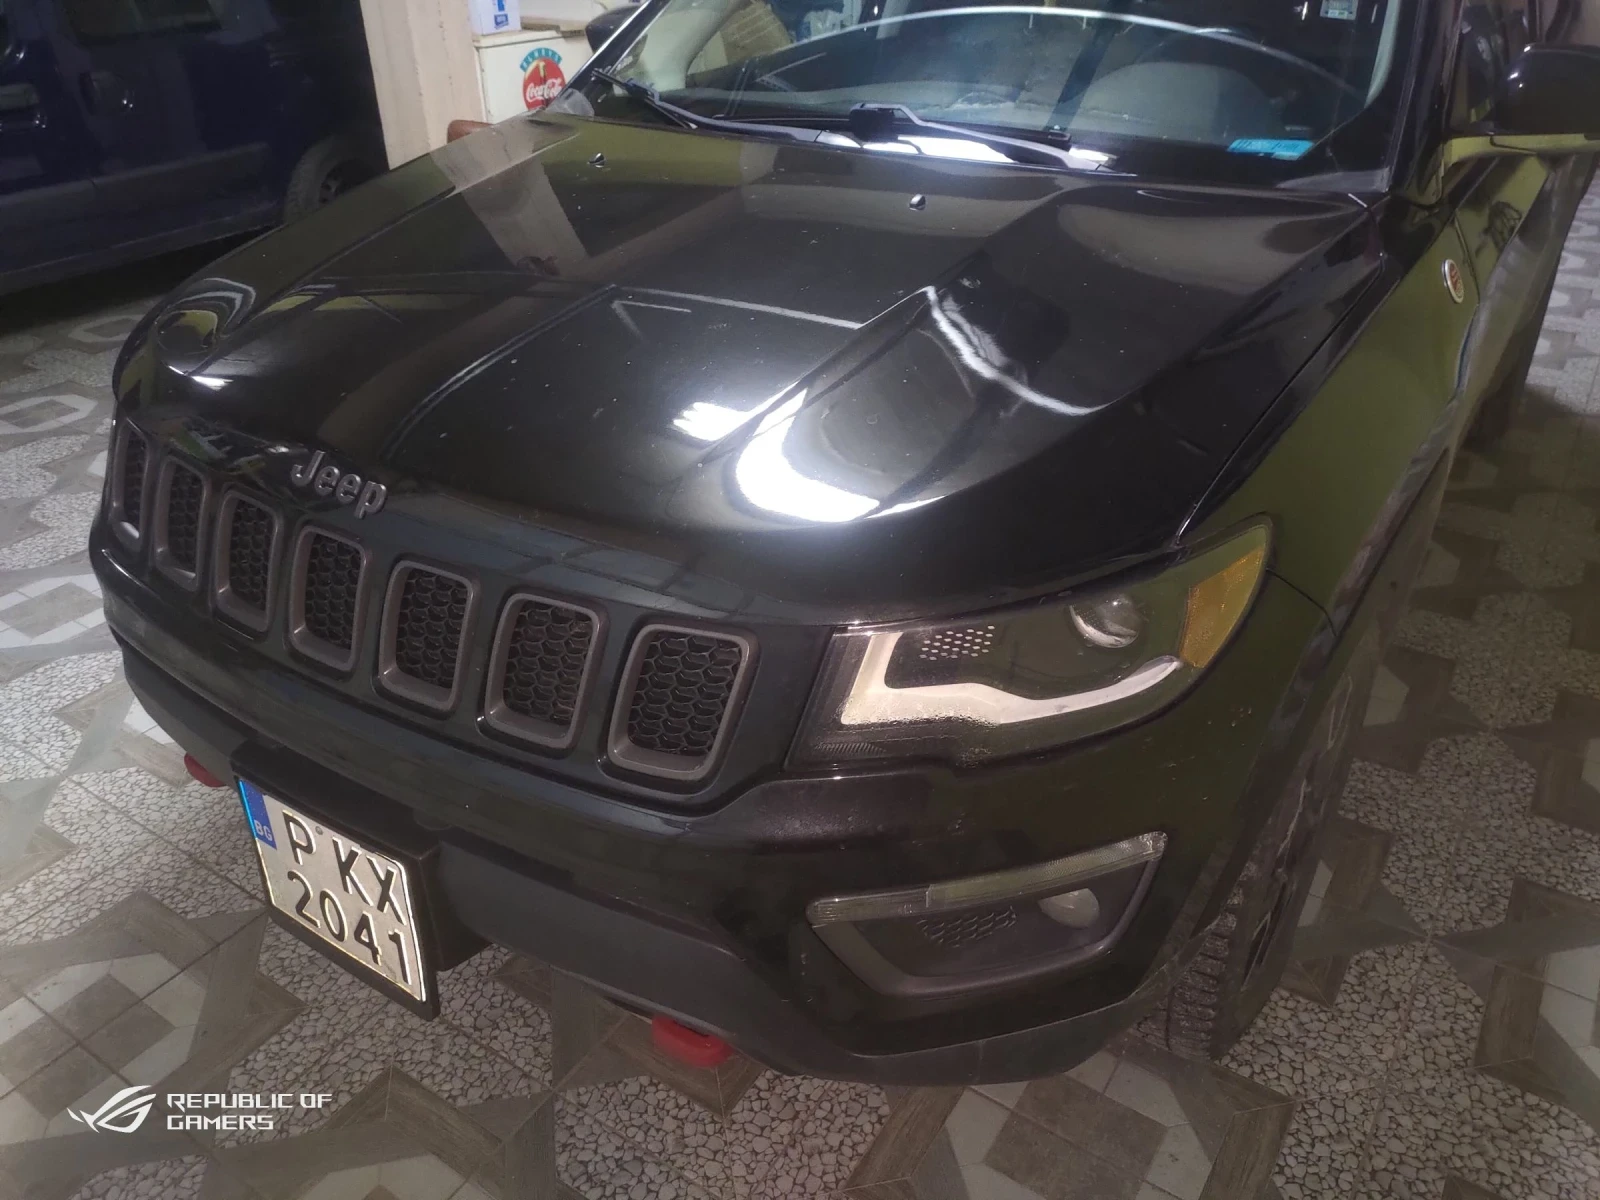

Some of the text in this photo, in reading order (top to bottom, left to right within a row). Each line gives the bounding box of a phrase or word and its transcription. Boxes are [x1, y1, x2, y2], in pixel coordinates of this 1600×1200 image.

[290, 450, 387, 519] Jeep
[254, 819, 273, 842] BG
[282, 809, 408, 926] P KX
[287, 870, 412, 986] 2041
